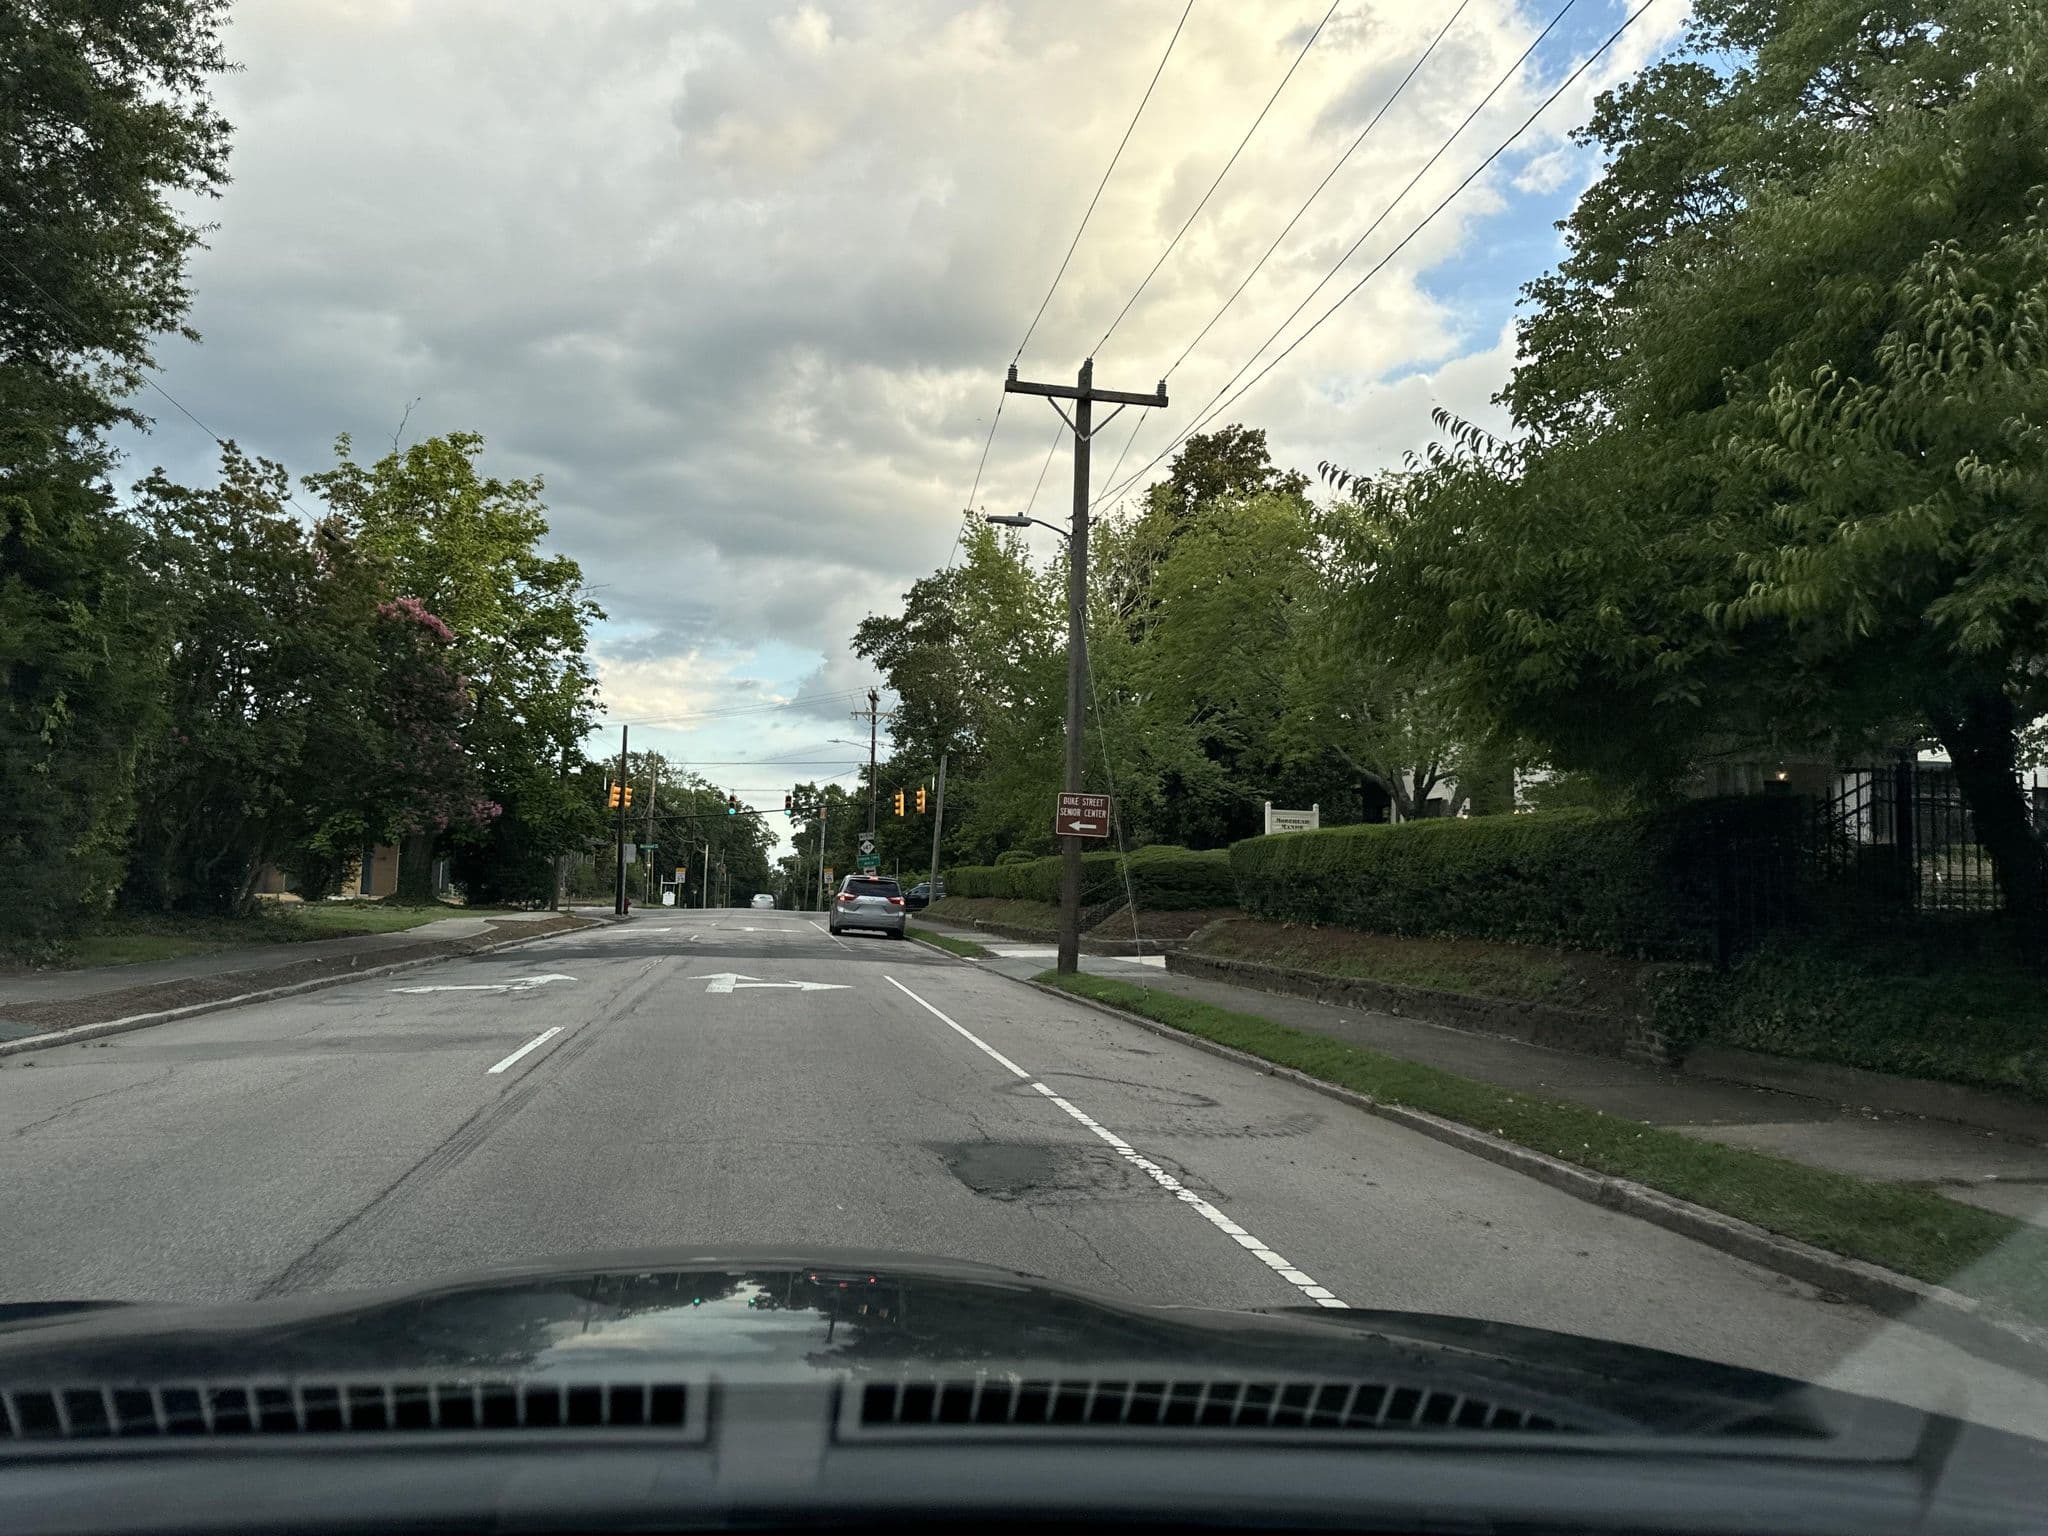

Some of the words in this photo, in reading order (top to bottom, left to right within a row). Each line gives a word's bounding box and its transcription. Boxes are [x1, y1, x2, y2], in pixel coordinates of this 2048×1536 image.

[1064, 797, 1079, 805] DUKE
[1082, 798, 1103, 807] STREET
[1060, 808, 1080, 816] SENIOR
[1084, 810, 1106, 818] CENTER
